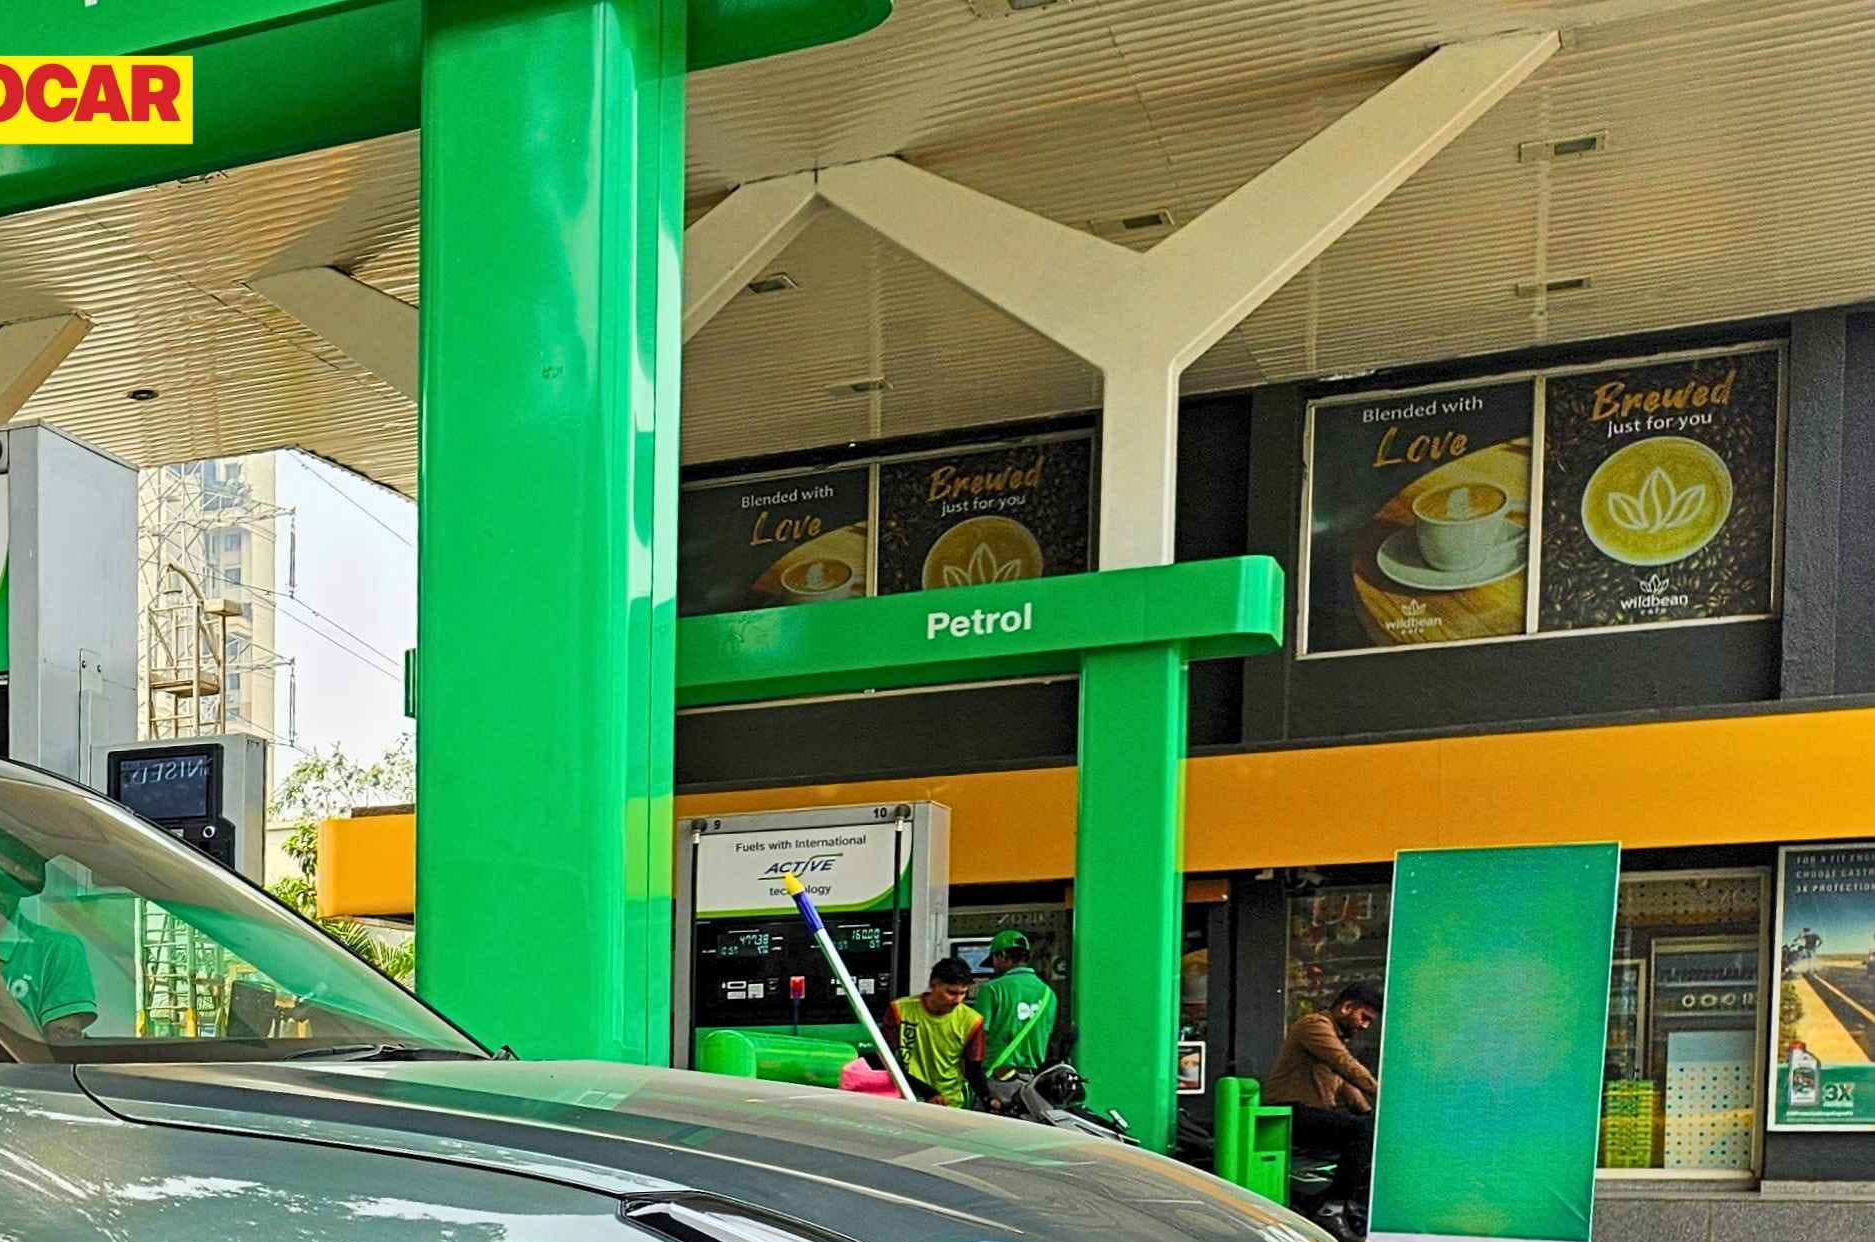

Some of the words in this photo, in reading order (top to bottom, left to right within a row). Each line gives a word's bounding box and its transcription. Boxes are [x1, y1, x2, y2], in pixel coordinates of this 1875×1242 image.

[1589, 369, 1737, 422] Brewed
[1363, 400, 1437, 423] Blended
[1442, 395, 1483, 413] with
[1607, 420, 1641, 438] just
[1646, 415, 1674, 431] for
[1678, 413, 1713, 431] you
[1373, 425, 1469, 468] Love
[926, 455, 1045, 502] Brewed
[741, 488, 798, 508] Blended
[801, 484, 834, 500] with
[940, 501, 970, 517] just
[973, 496, 996, 510] for
[998, 494, 1026, 511] you
[749, 511, 822, 546] Love
[927, 602, 1033, 640] Petrol
[713, 819, 722, 830] 9
[873, 807, 888, 819] 10
[735, 841, 766, 853] Fuels
[769, 839, 793, 851] with
[795, 835, 867, 850] International
[764, 857, 837, 875] ACTIVE
[1824, 1084, 1851, 1102] 3X
